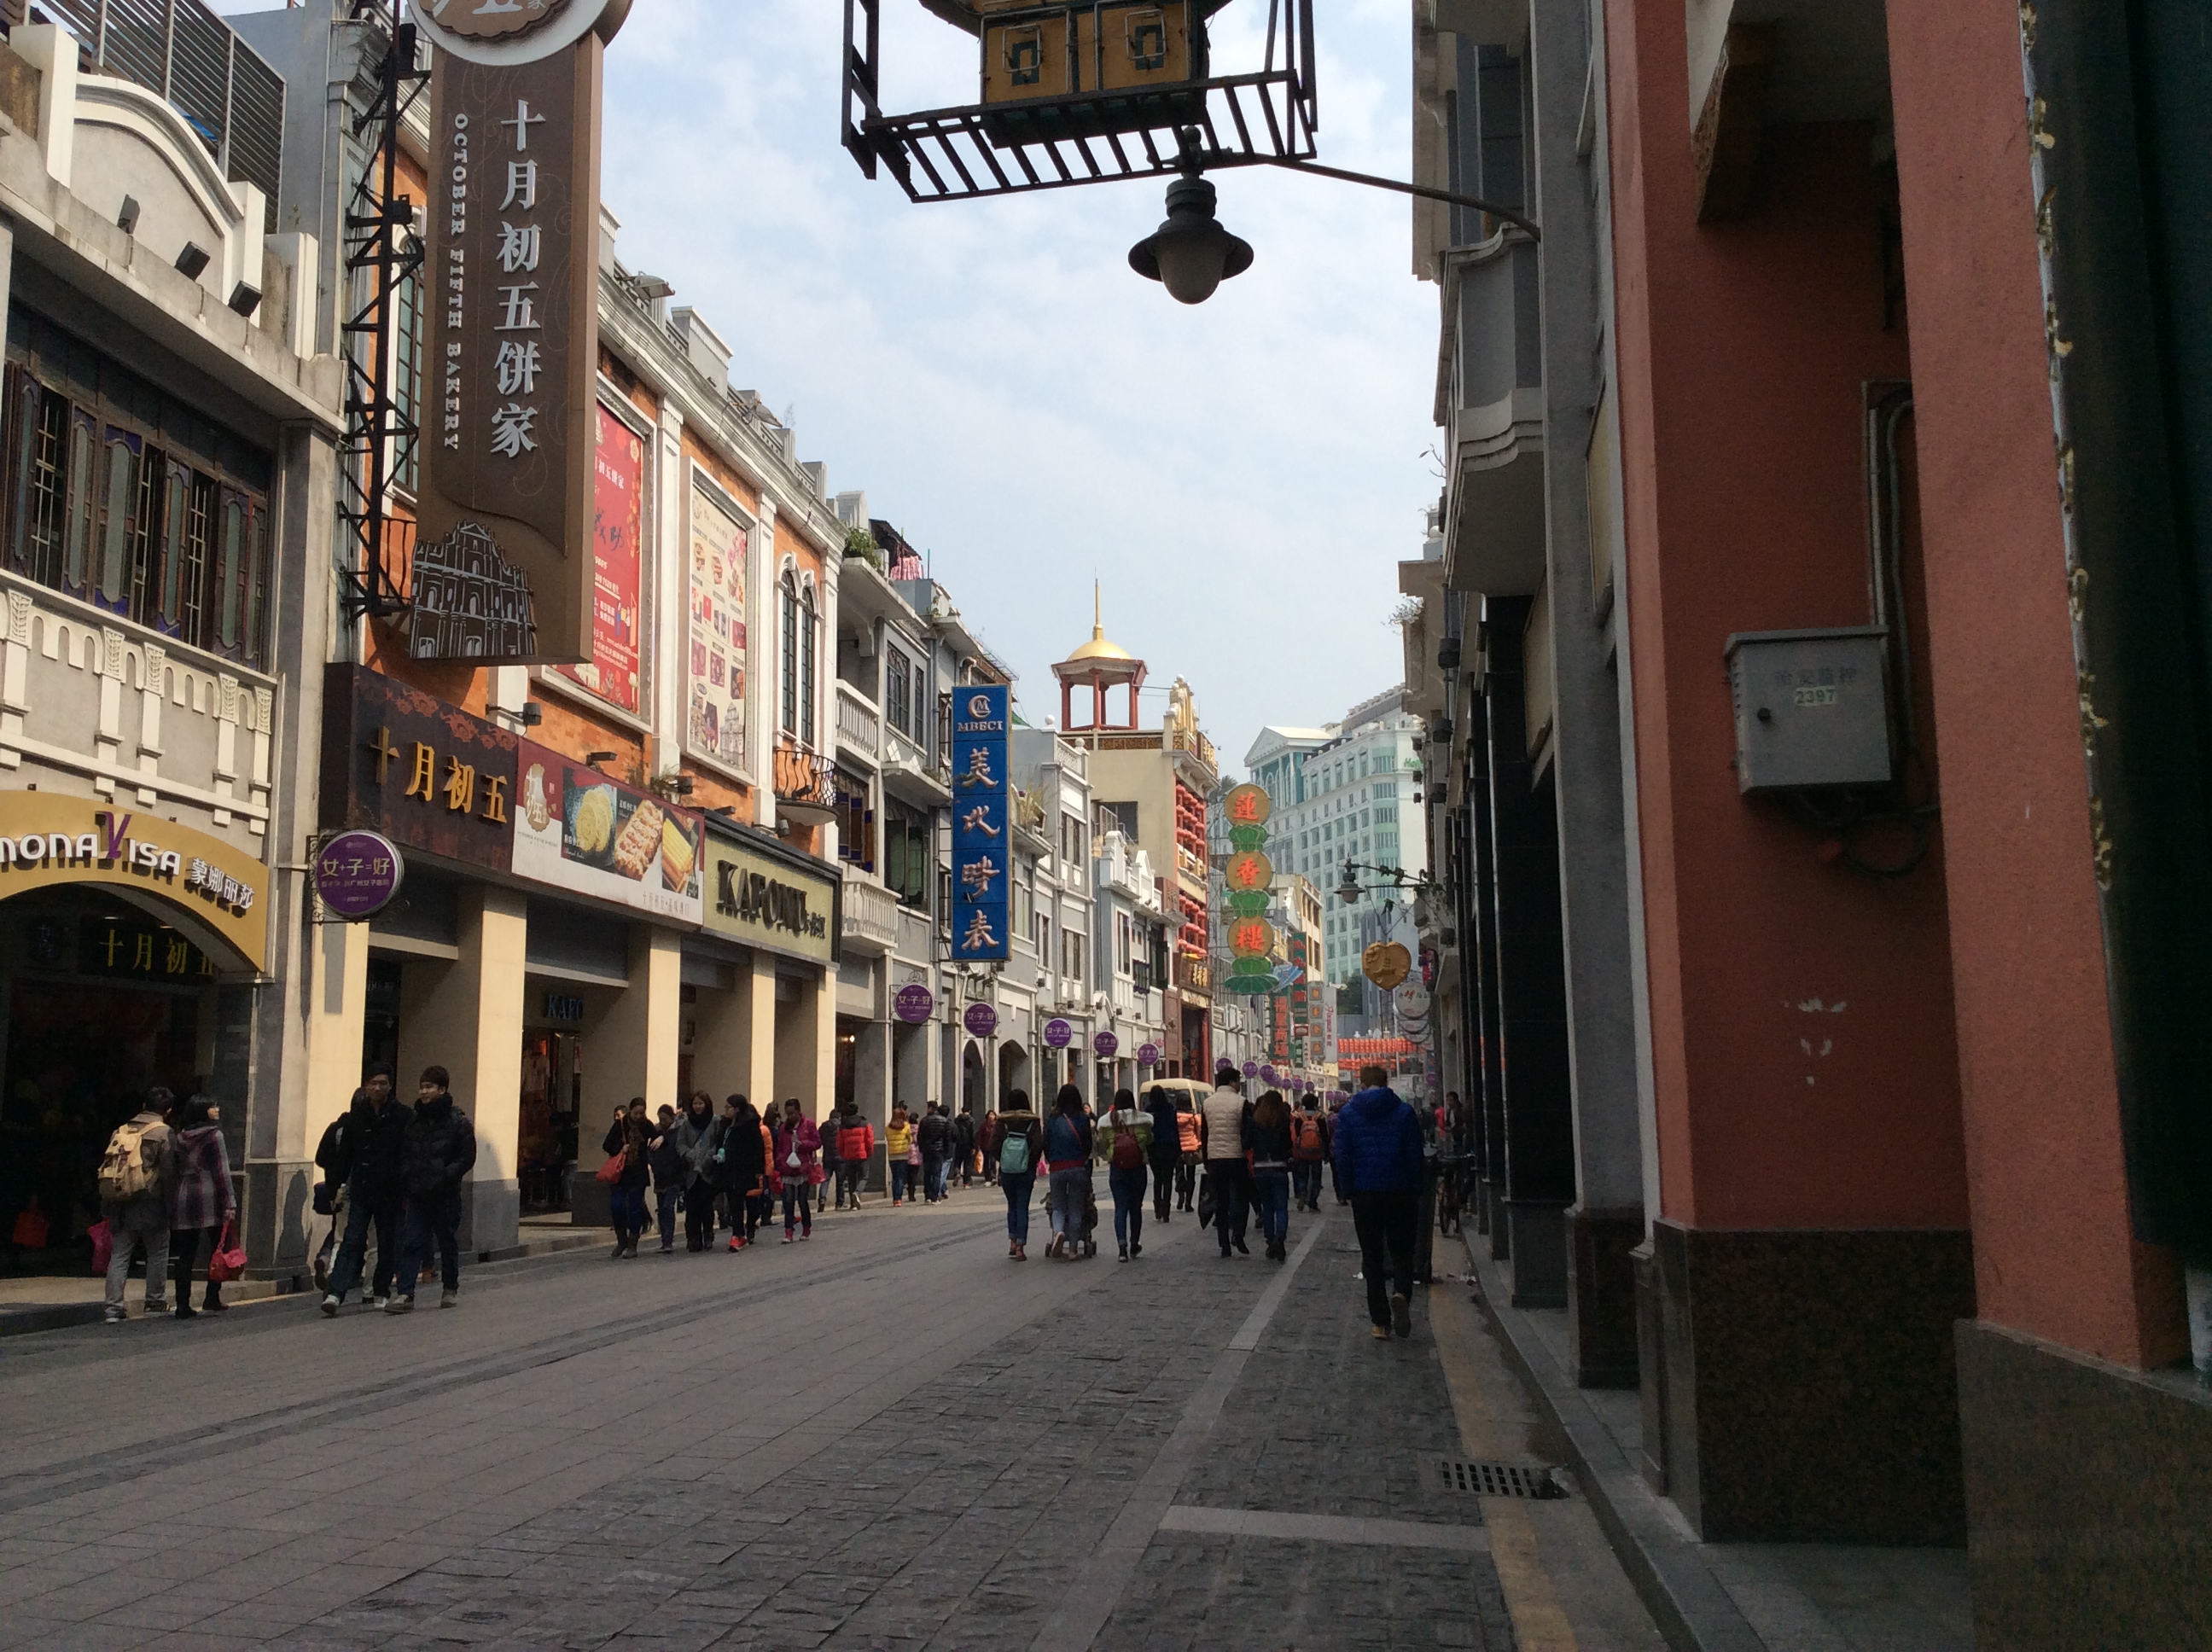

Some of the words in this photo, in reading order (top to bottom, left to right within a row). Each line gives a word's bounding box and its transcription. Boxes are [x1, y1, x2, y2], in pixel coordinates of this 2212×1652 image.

[450, 113, 469, 236] OCTOBER
[447, 249, 465, 329] FIFTH
[490, 99, 546, 458] 十月初五饼家
[444, 342, 462, 450] BAKERY
[1796, 688, 1836, 704] 2397
[370, 726, 509, 824] 十月初五
[189, 858, 254, 910] 蒙娜丽莎
